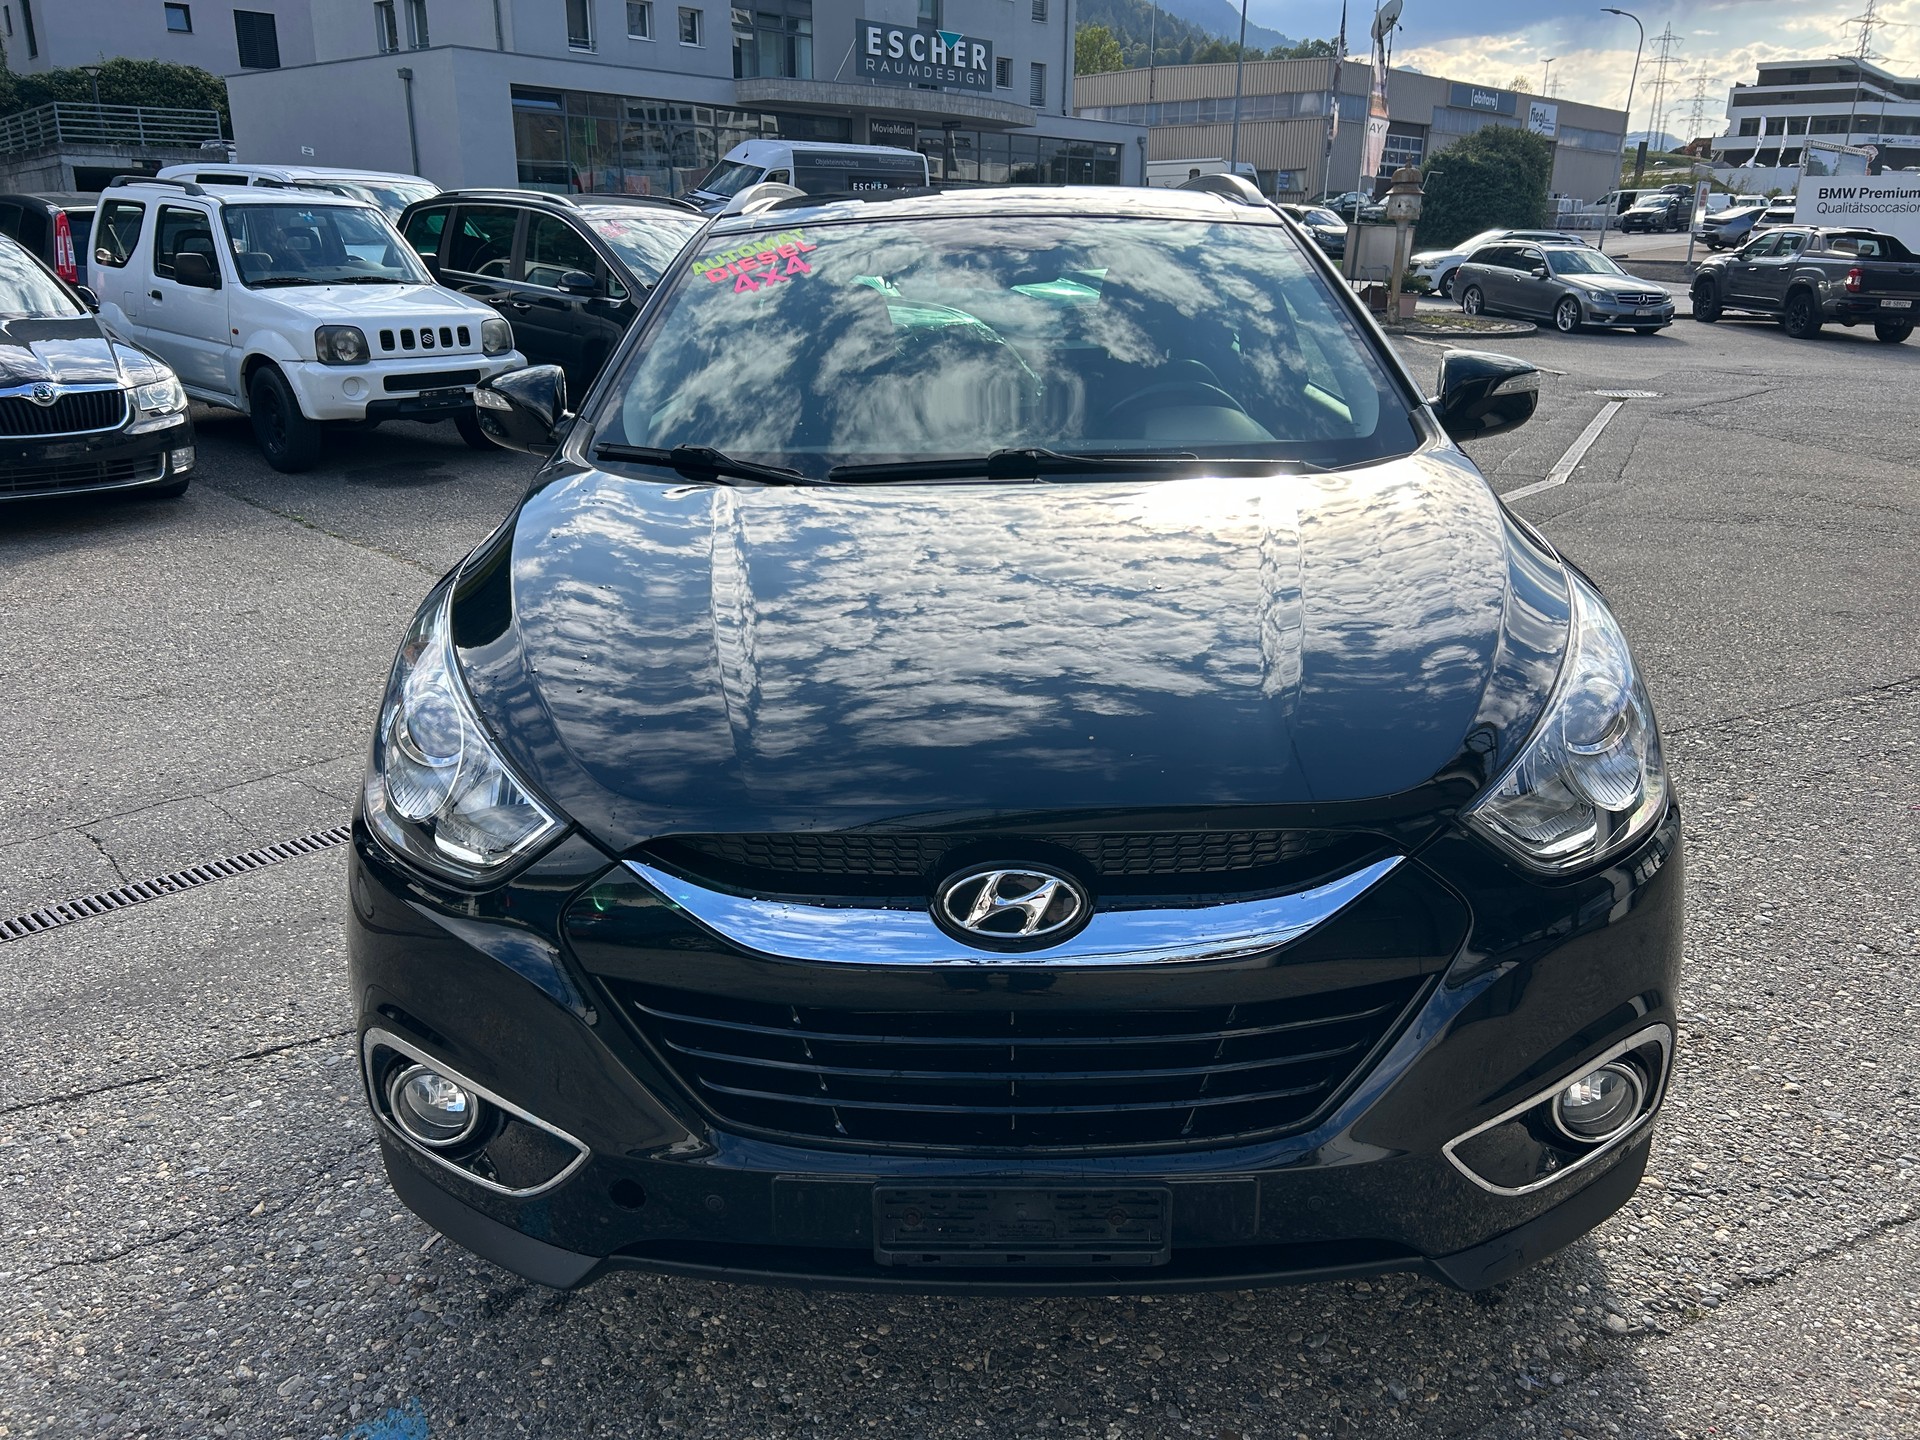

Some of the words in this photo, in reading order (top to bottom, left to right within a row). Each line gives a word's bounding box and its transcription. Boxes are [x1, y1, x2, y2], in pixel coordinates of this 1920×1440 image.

[866, 26, 987, 71] ESCHER
[865, 58, 986, 85] RAUMDESIGN
[871, 122, 913, 135] MovieMaint
[1818, 187, 1857, 199] BMW
[1859, 187, 1920, 199] Premium
[692, 228, 806, 276] AUTOMAT
[704, 241, 817, 283] DIESEL
